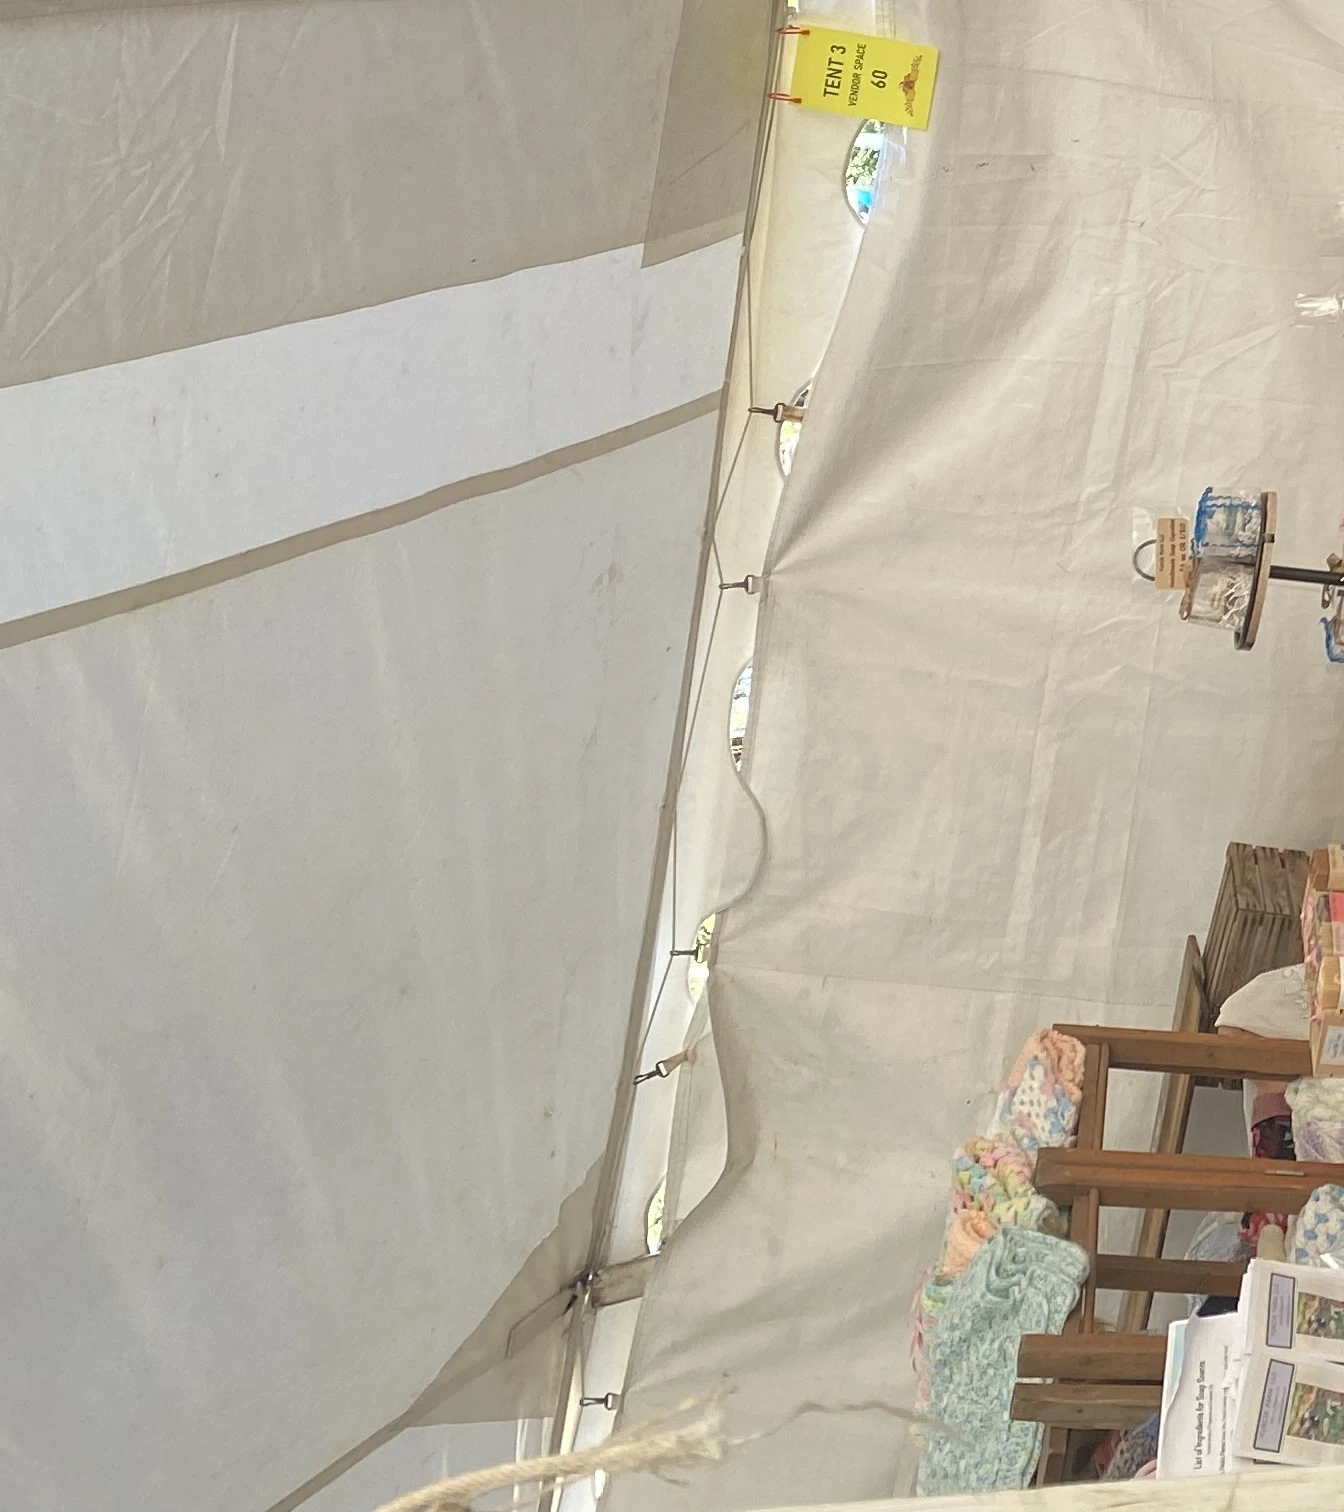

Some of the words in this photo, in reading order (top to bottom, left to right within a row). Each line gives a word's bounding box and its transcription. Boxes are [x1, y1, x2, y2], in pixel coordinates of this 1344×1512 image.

[829, 45, 846, 55] 3
[852, 43, 867, 71] SPACE
[822, 57, 845, 98] TENT
[847, 73, 863, 107] VENDOR
[870, 70, 888, 89] 60
